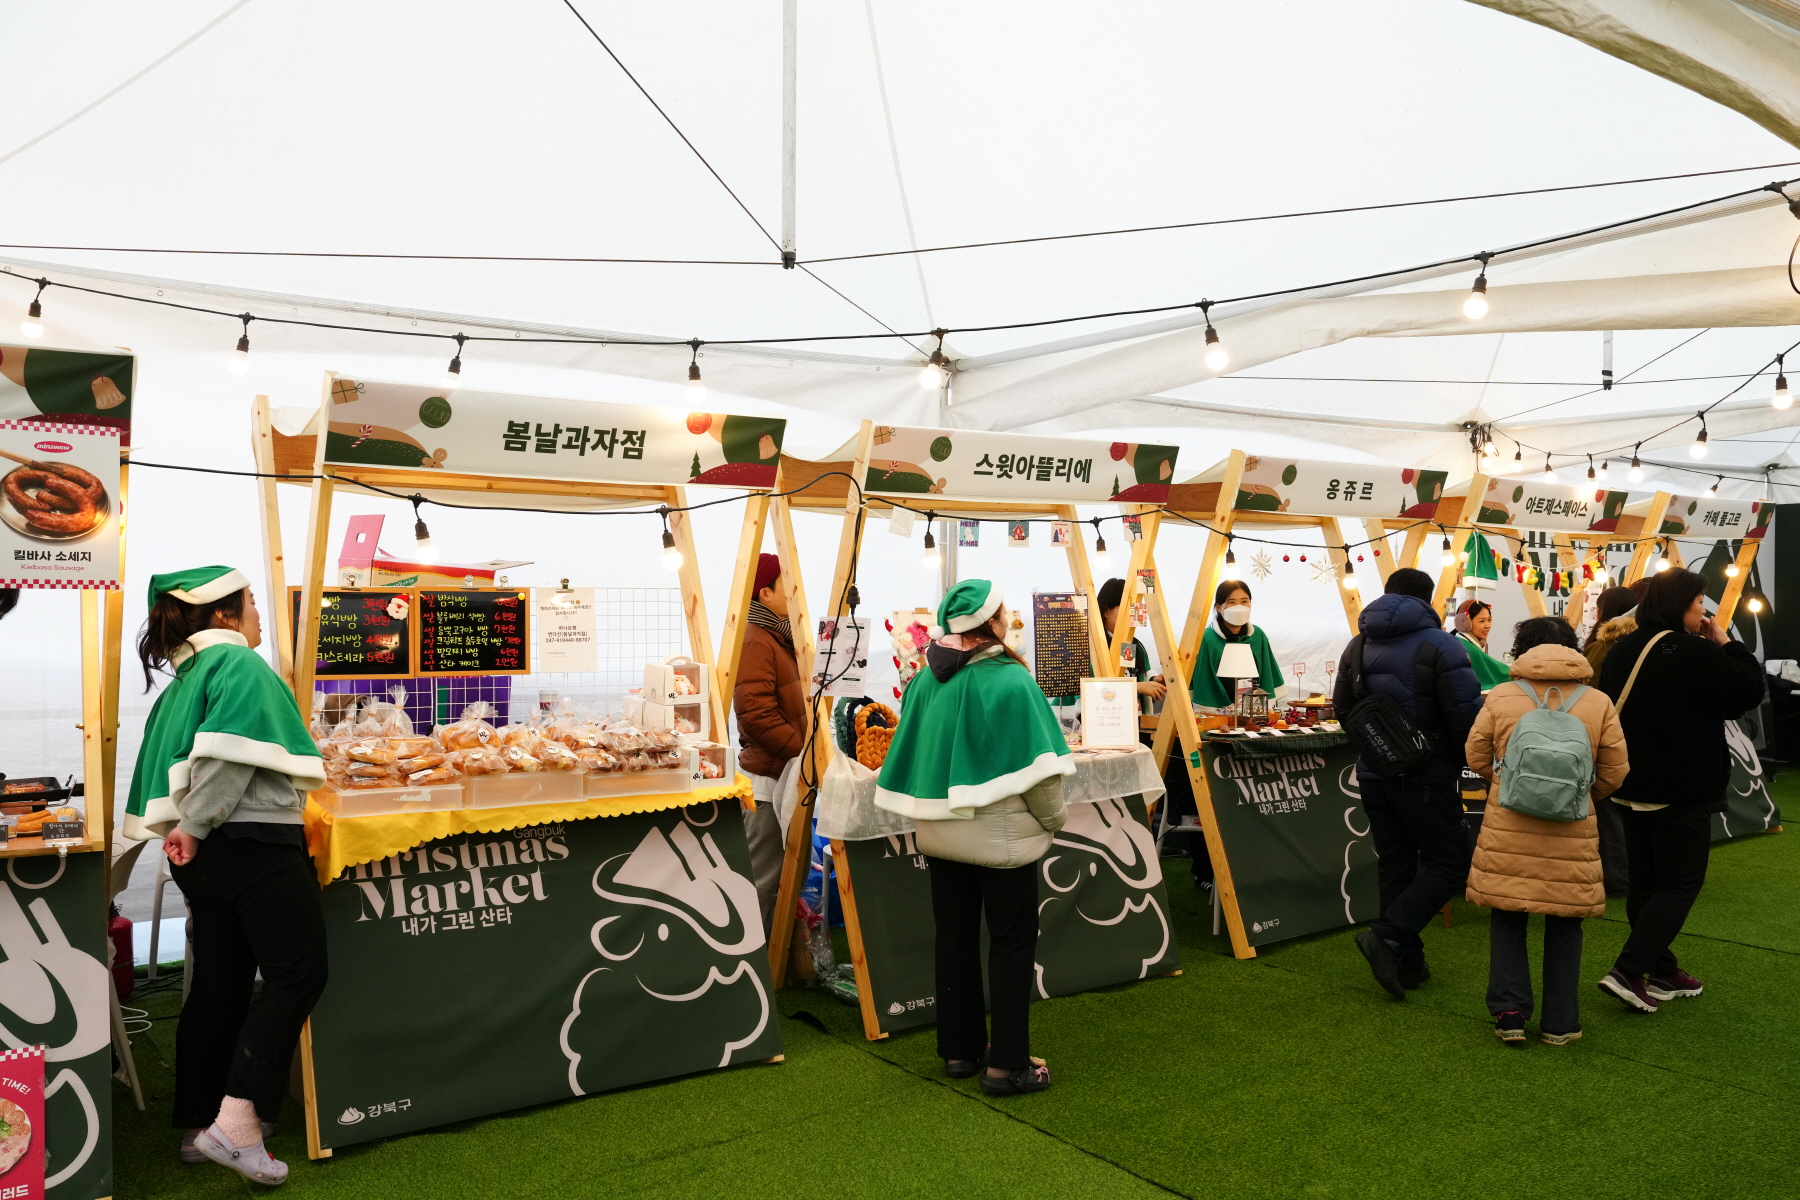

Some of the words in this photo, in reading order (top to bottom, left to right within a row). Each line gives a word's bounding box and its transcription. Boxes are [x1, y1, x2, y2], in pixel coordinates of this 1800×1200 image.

[502, 420, 646, 460] 봄날과자점
[973, 453, 1093, 484] 스윗아뜰리에
[1326, 478, 1374, 502] 옹쥬르
[1525, 496, 1588, 518] 아트제스페이스
[1703, 510, 1721, 527] 카페
[14, 550, 51, 561] 킬바사
[55, 551, 91, 562] 소세지
[53, 564, 85, 572] Sausage
[362, 614, 390, 626] 3천원
[477, 626, 489, 636] 빵
[318, 634, 362, 648] 세지빵
[367, 652, 395, 664] 5천원
[439, 659, 456, 669] 산타
[1213, 751, 1326, 779] Christmas
[1233, 770, 1321, 806] Market
[1258, 802, 1274, 816] 내가
[1274, 800, 1291, 813] 그린
[1291, 798, 1307, 811] 산타
[513, 824, 566, 840] Gangbuk
[350, 863, 550, 923] Market
[401, 915, 437, 936] 내가
[442, 911, 475, 931] 그린
[479, 907, 513, 927] 산타
[906, 996, 935, 1011] 강북구
[2, 1077, 31, 1096] TIME!
[367, 1098, 412, 1118] 강북구
[0, 1184, 29, 1200] 러드
